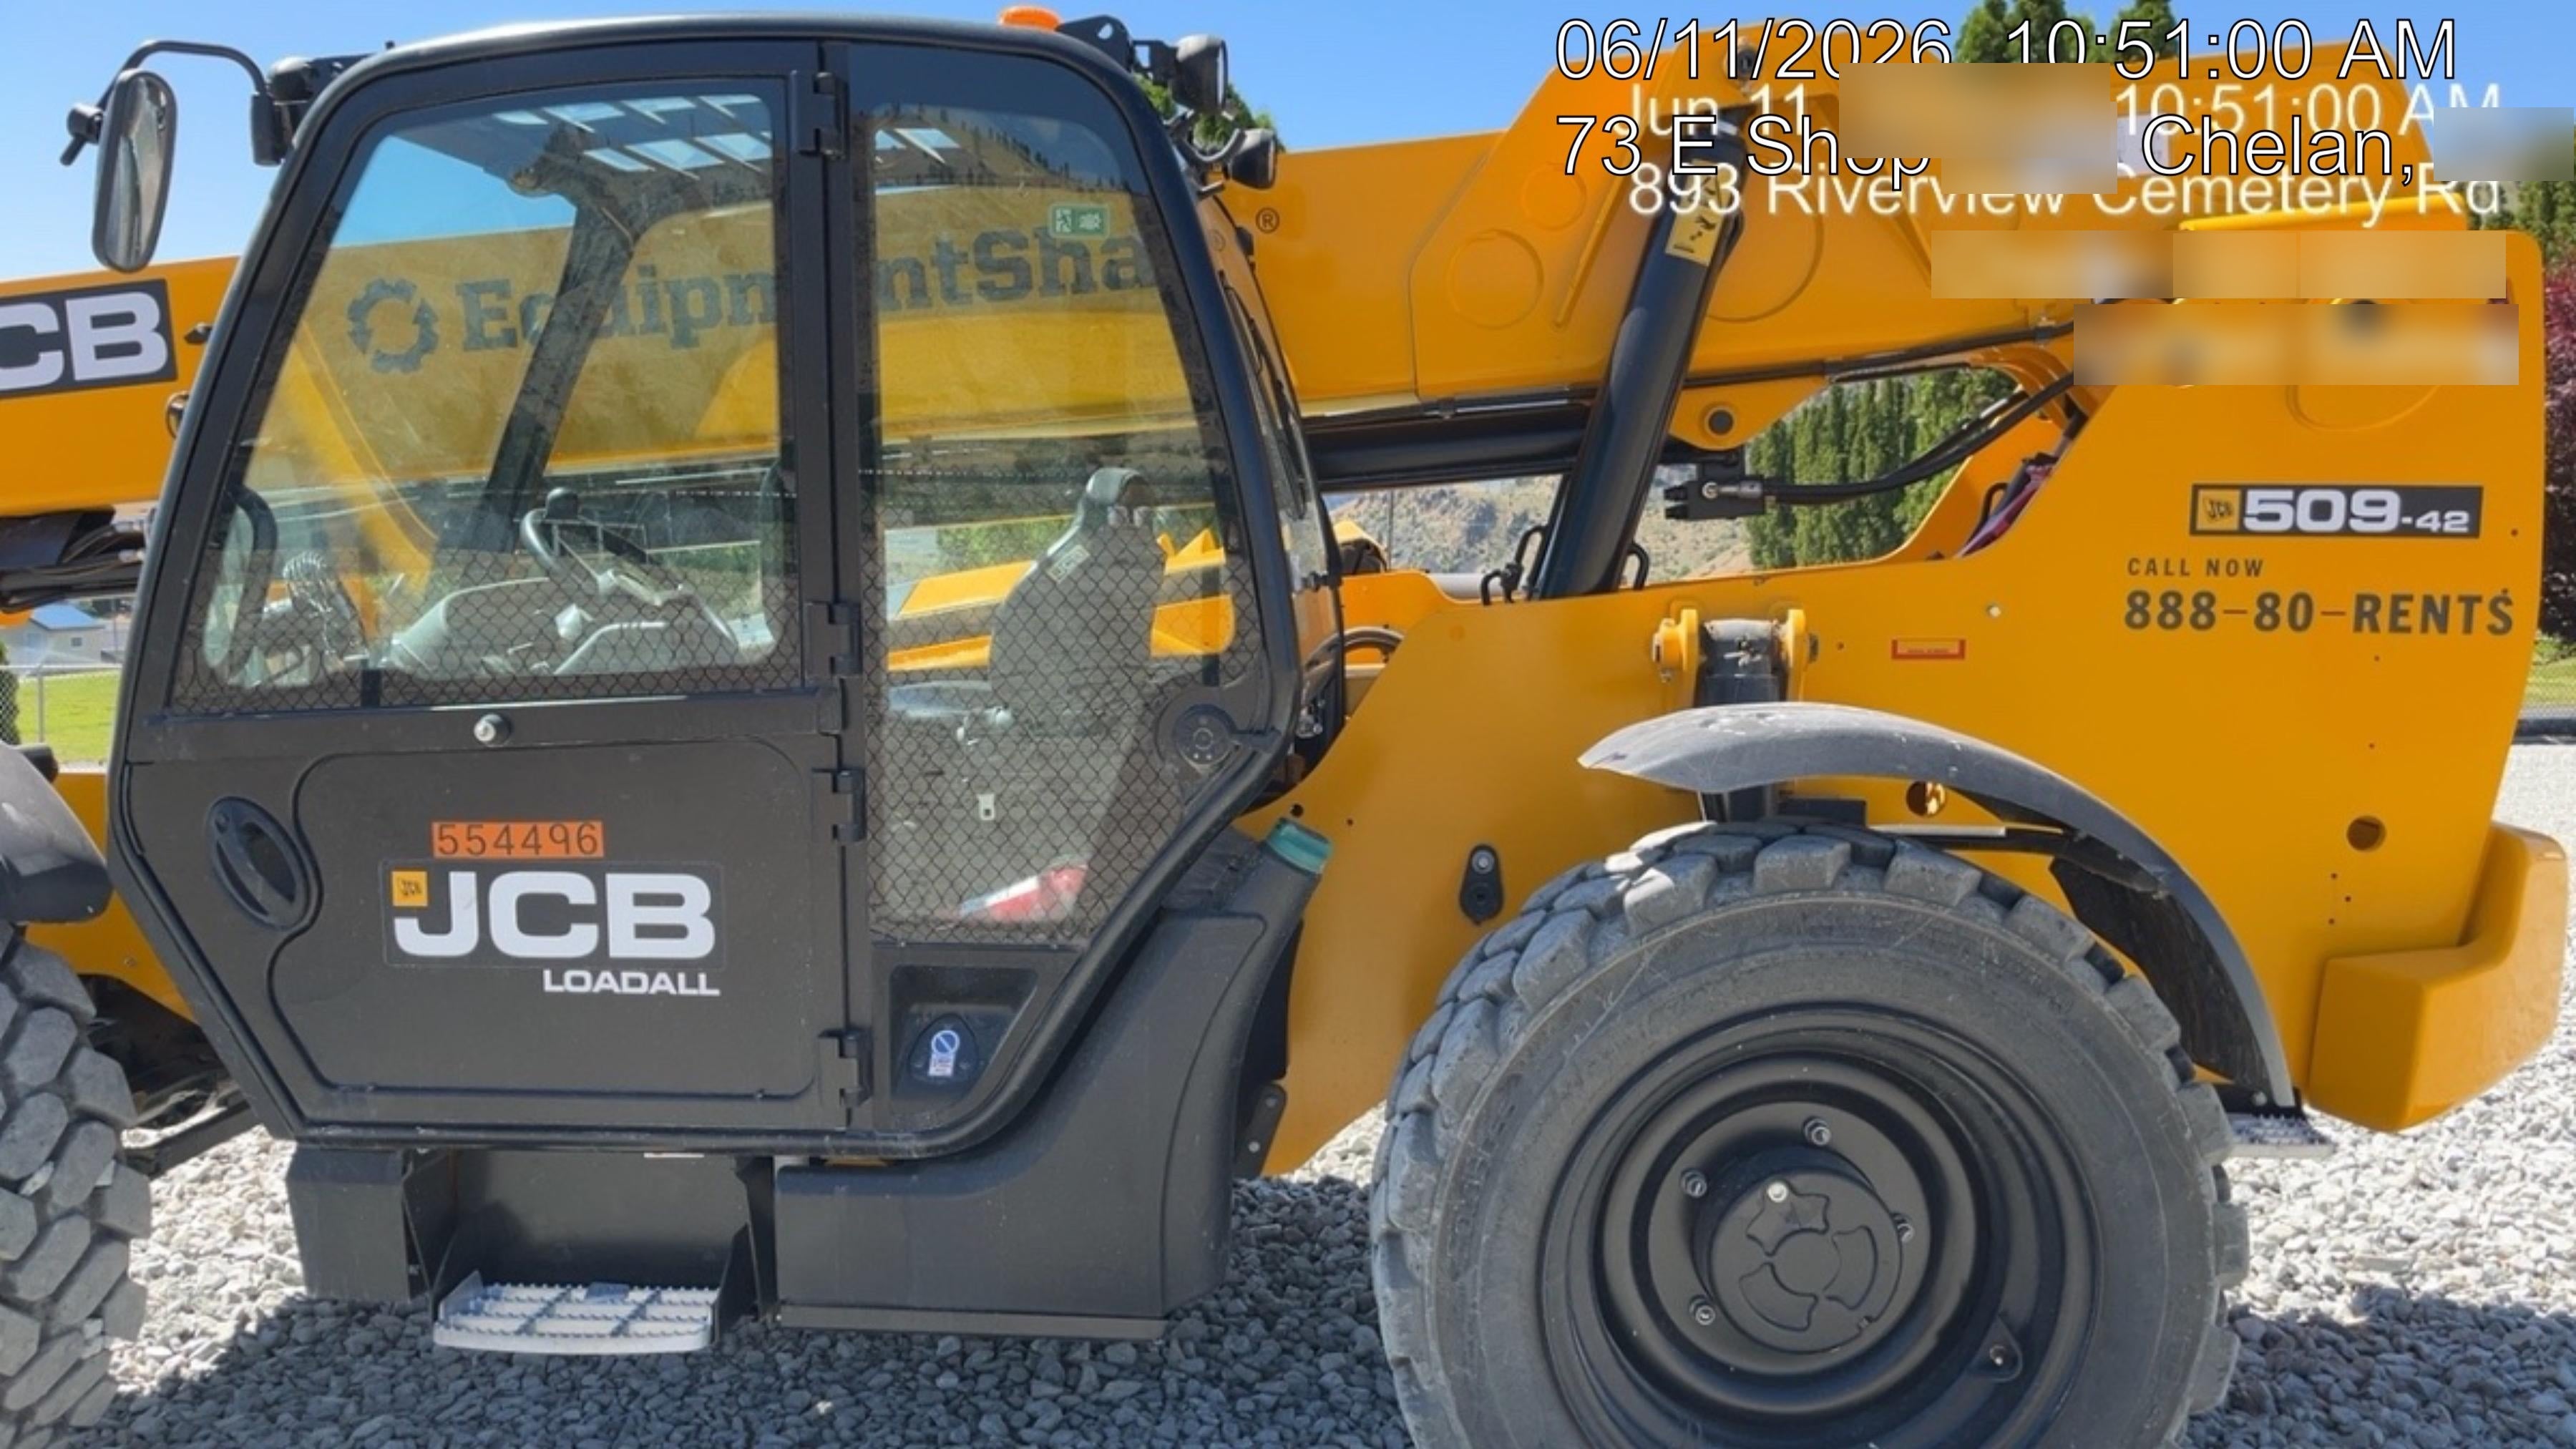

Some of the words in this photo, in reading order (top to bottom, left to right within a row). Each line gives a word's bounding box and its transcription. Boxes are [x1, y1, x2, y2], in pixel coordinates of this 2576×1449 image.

[2243, 489, 2469, 533] 509-42
[2127, 557, 2191, 577] CALL
[2205, 558, 2265, 577] NOW
[436, 822, 599, 857] 554496
[394, 870, 716, 960] JCB
[542, 968, 721, 996] LOADALL
